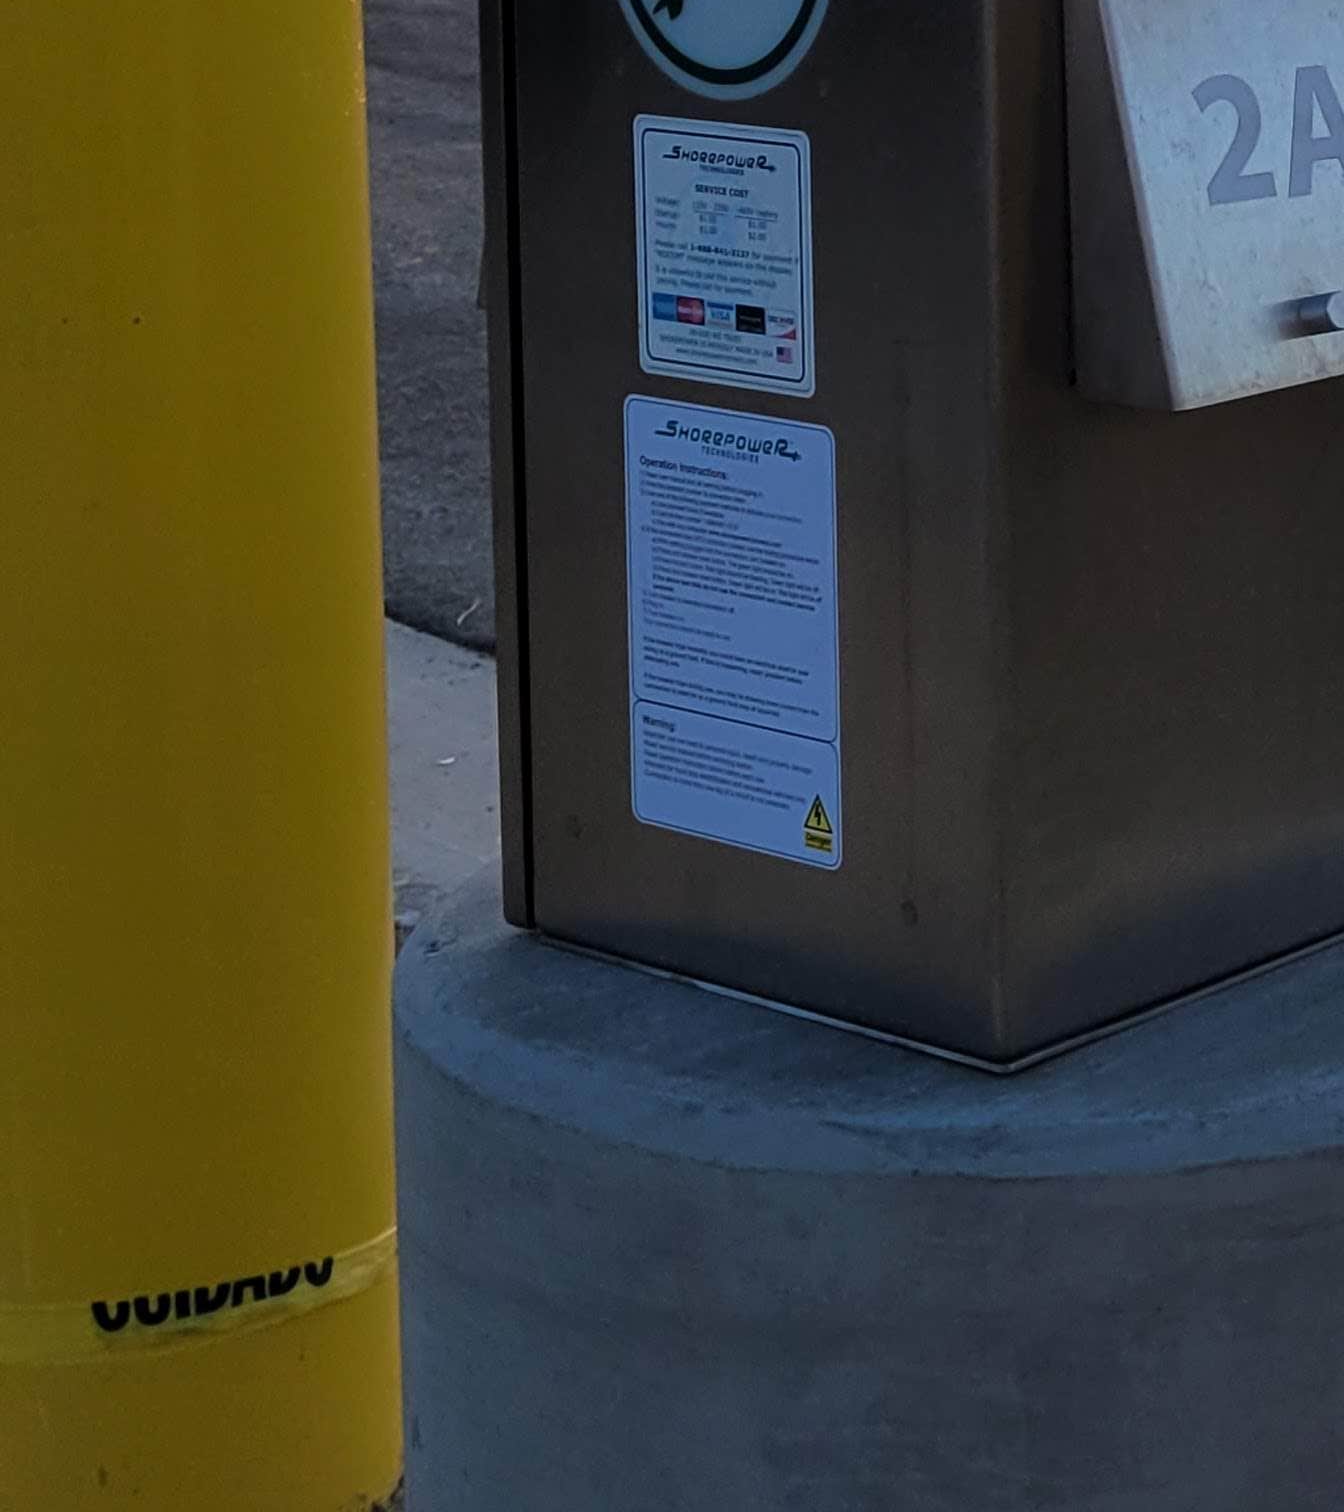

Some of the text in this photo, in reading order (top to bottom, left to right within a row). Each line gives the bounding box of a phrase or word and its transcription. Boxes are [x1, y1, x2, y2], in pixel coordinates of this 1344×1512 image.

[695, 184, 749, 199] SERVICE COST
[639, 455, 678, 471] Operation
